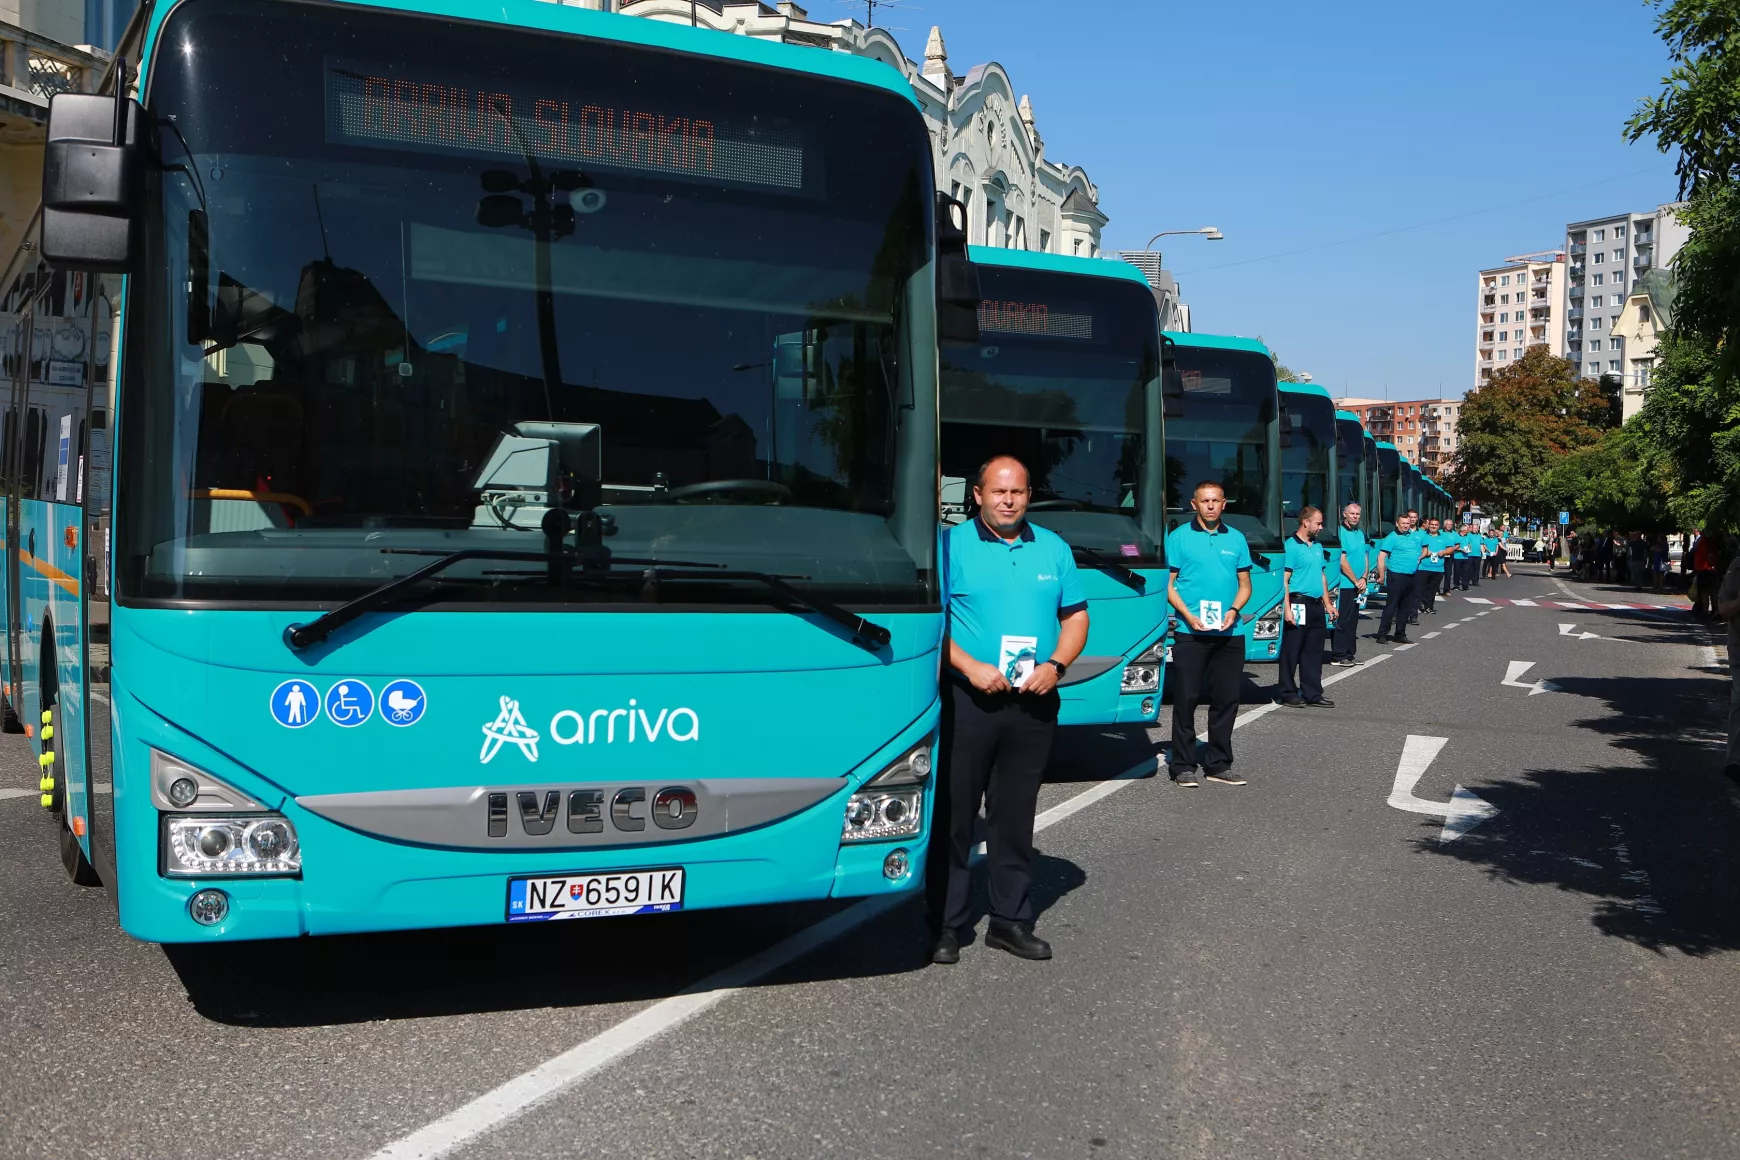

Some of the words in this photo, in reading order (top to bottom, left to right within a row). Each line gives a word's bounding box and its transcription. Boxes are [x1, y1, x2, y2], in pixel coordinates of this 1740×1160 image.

[365, 76, 511, 147] ARRIVA
[534, 99, 714, 172] SLOVAKIA
[981, 299, 1048, 332] OVAKIA
[550, 698, 699, 745] arriva
[487, 785, 699, 838] IVECO
[512, 900, 524, 909] SK
[529, 880, 567, 910] NZ
[577, 909, 610, 917] COREX
